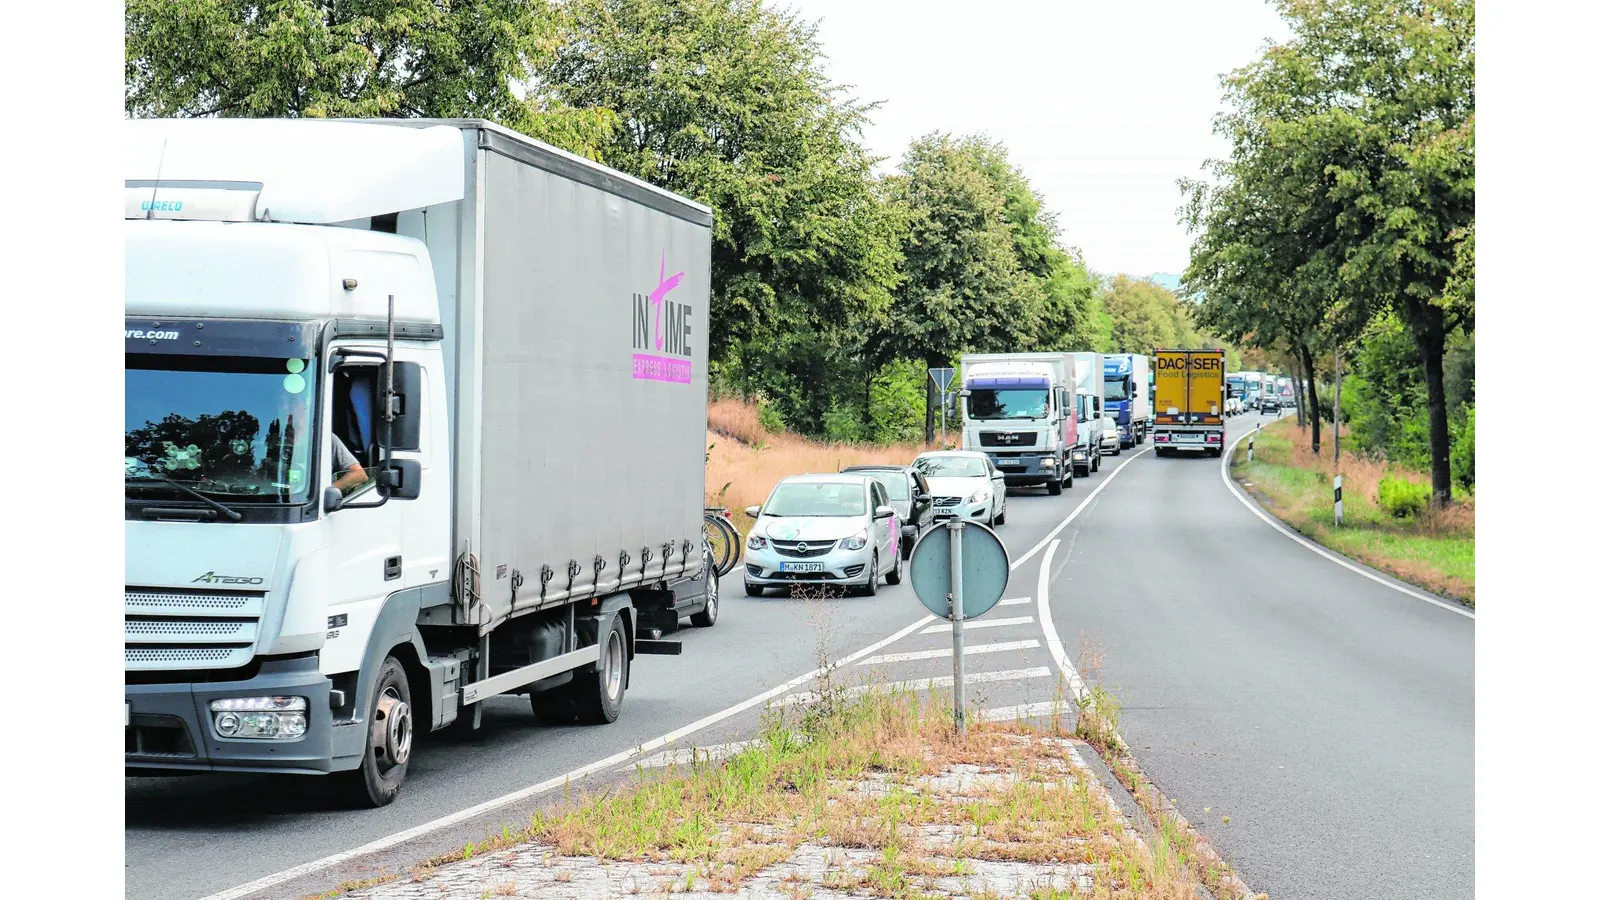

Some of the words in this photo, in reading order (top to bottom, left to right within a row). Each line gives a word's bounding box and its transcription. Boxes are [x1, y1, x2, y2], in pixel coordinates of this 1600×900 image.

[1158, 357, 1220, 370] DACHSER
[1182, 371, 1219, 379] Logistics
[805, 563, 822, 571] 1871
